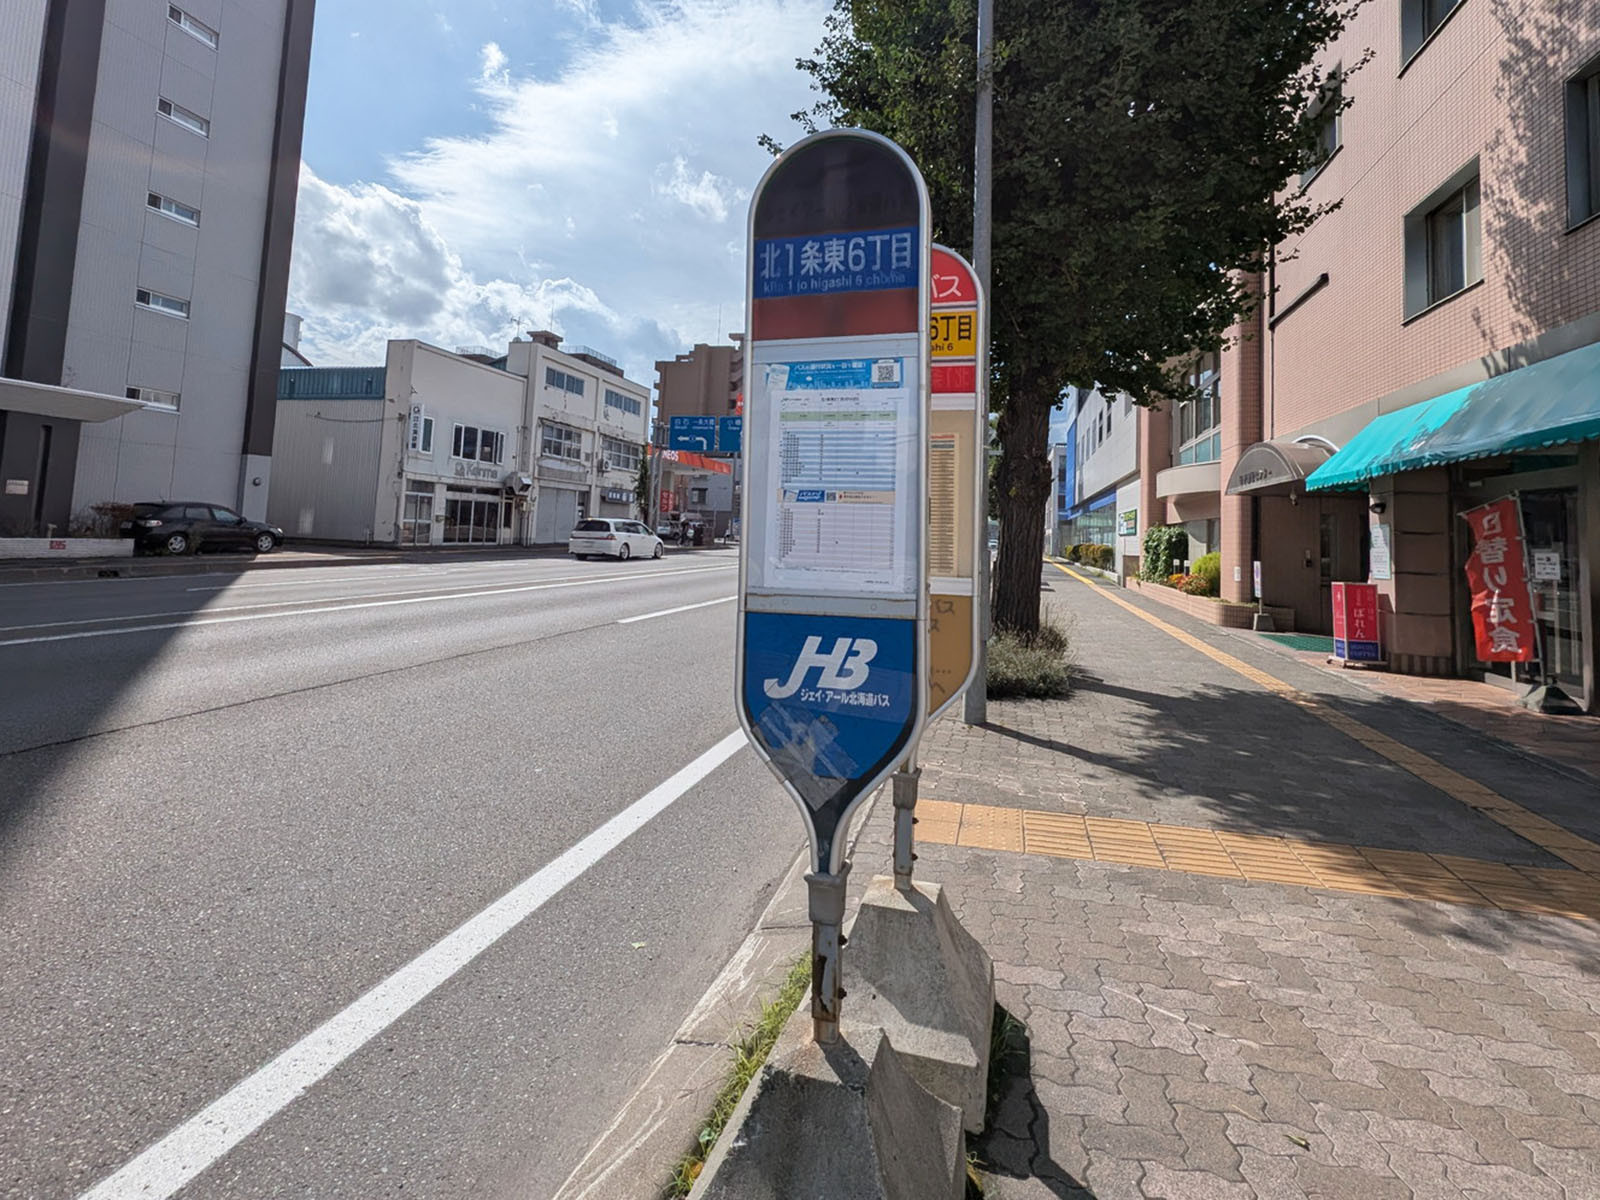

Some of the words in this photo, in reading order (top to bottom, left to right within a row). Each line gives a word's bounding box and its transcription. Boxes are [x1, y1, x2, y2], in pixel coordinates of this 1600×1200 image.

[760, 232, 911, 279] 北1条東6丁目
[810, 273, 852, 292] higashi
[855, 274, 863, 286] 6
[947, 342, 954, 351] 6
[800, 688, 891, 707] ジェイ・アール北海道バス
